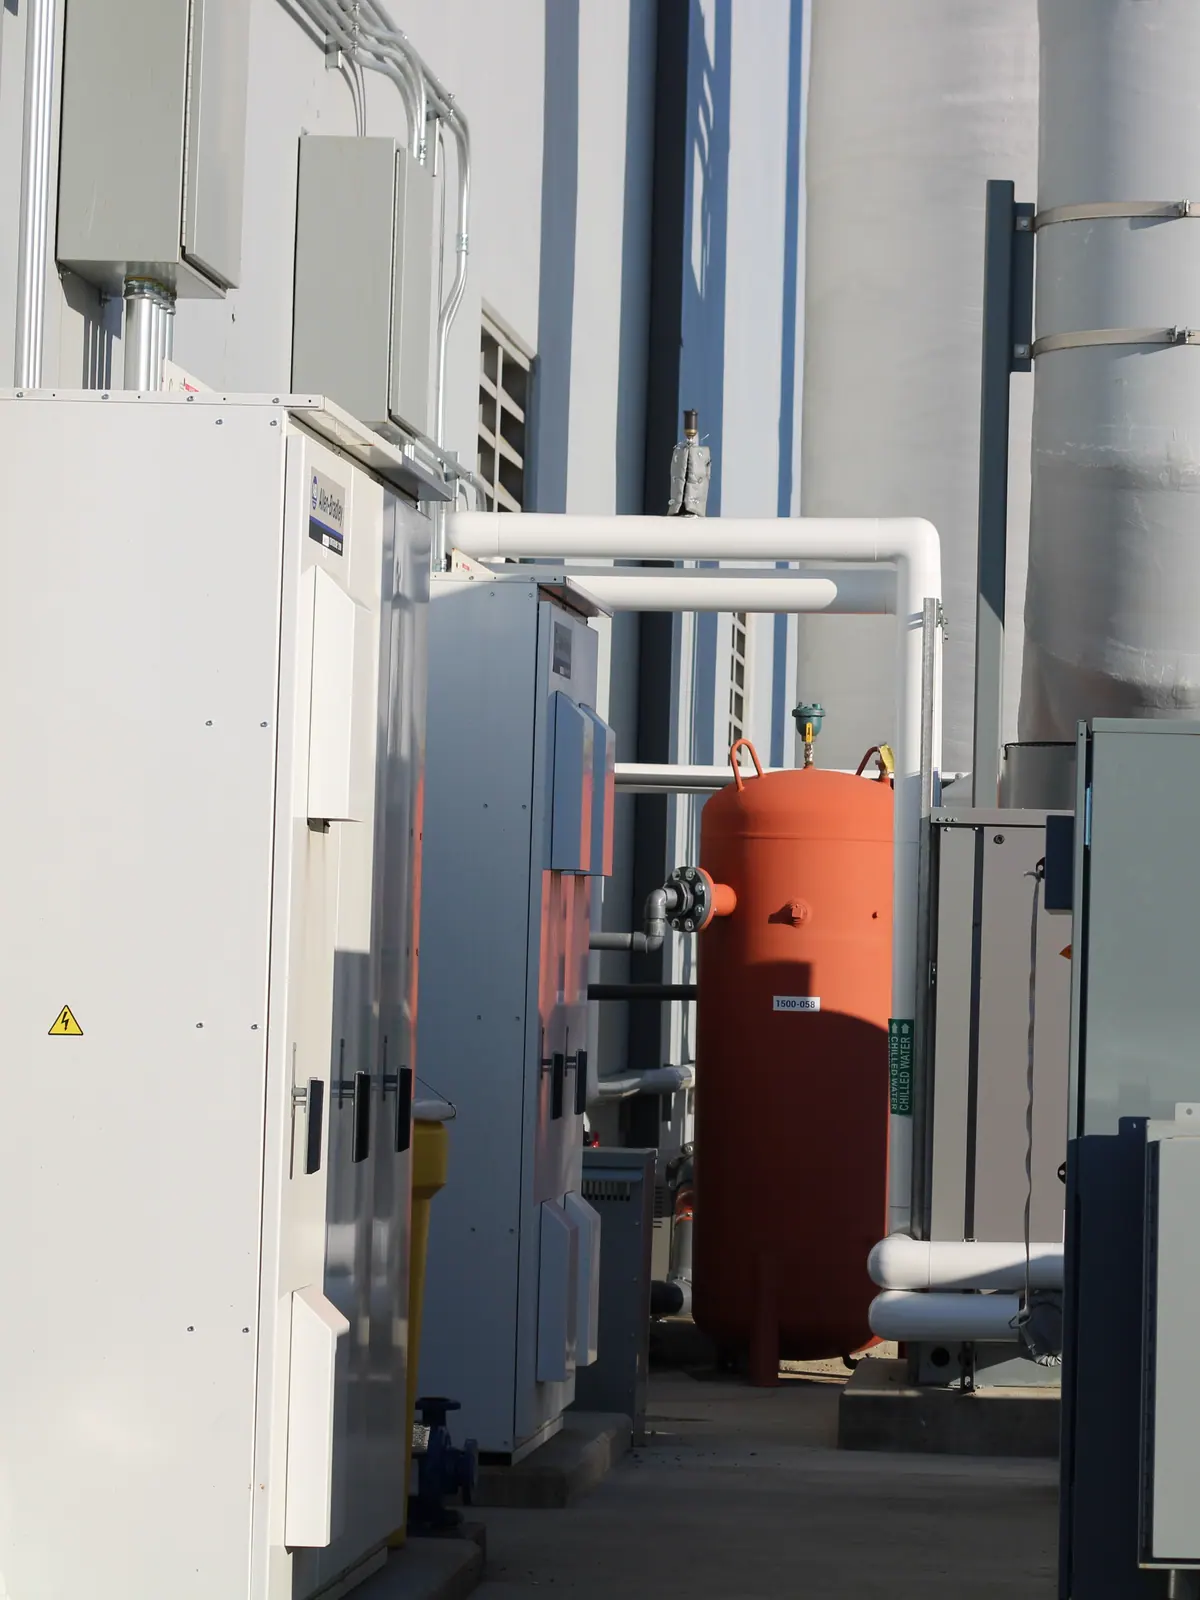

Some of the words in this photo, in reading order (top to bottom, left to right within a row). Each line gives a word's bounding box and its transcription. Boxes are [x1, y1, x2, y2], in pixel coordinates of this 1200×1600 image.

[775, 999, 816, 1009] 1500-058
[900, 1037, 910, 1070] WATER
[900, 1071, 910, 1111] CHILLED
